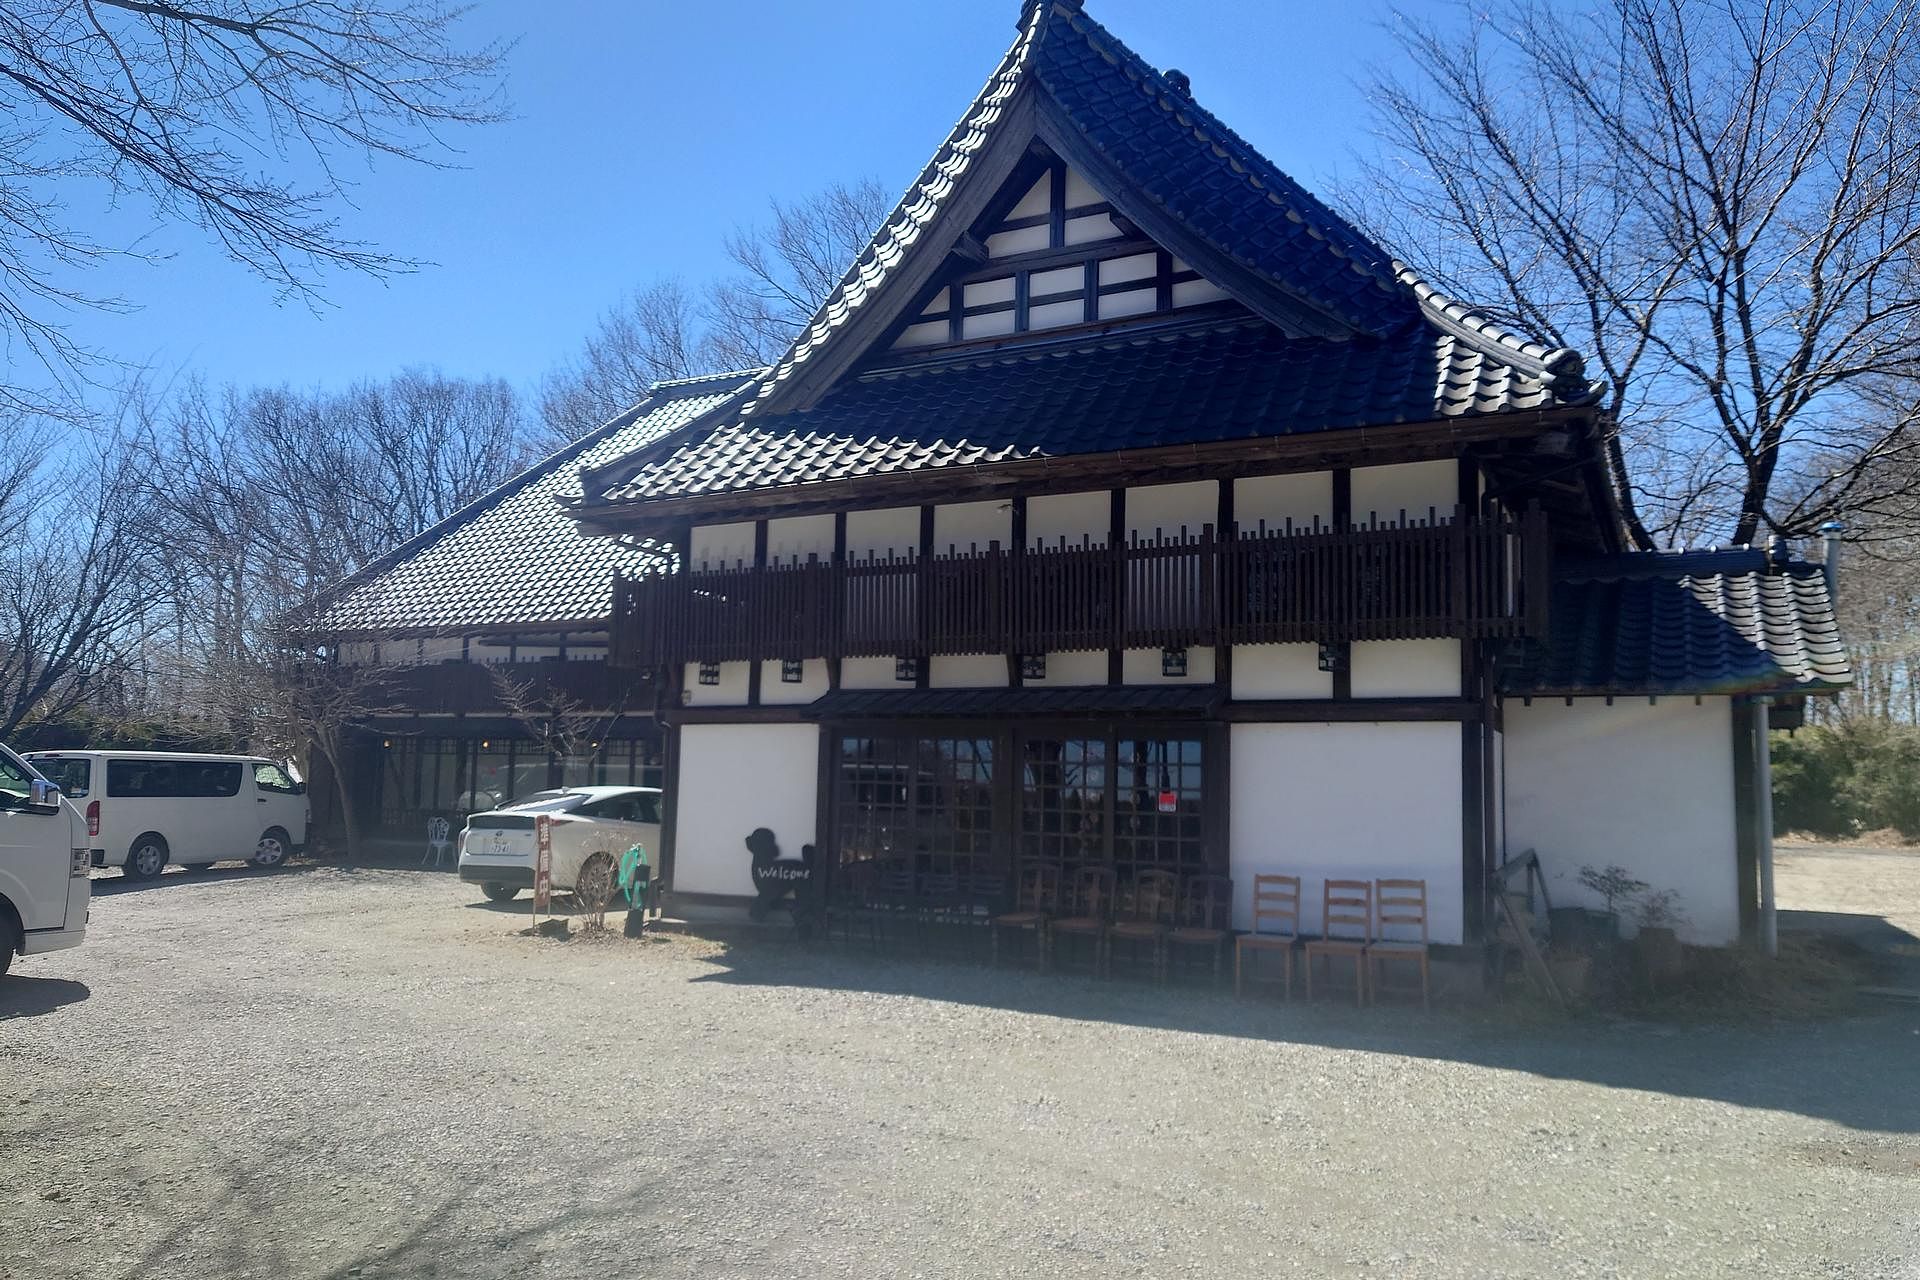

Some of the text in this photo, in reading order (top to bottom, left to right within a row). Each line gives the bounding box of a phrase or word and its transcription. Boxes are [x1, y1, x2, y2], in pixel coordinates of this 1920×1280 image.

[539, 822, 549, 898] 準備中
[758, 866, 810, 880] Welcome
